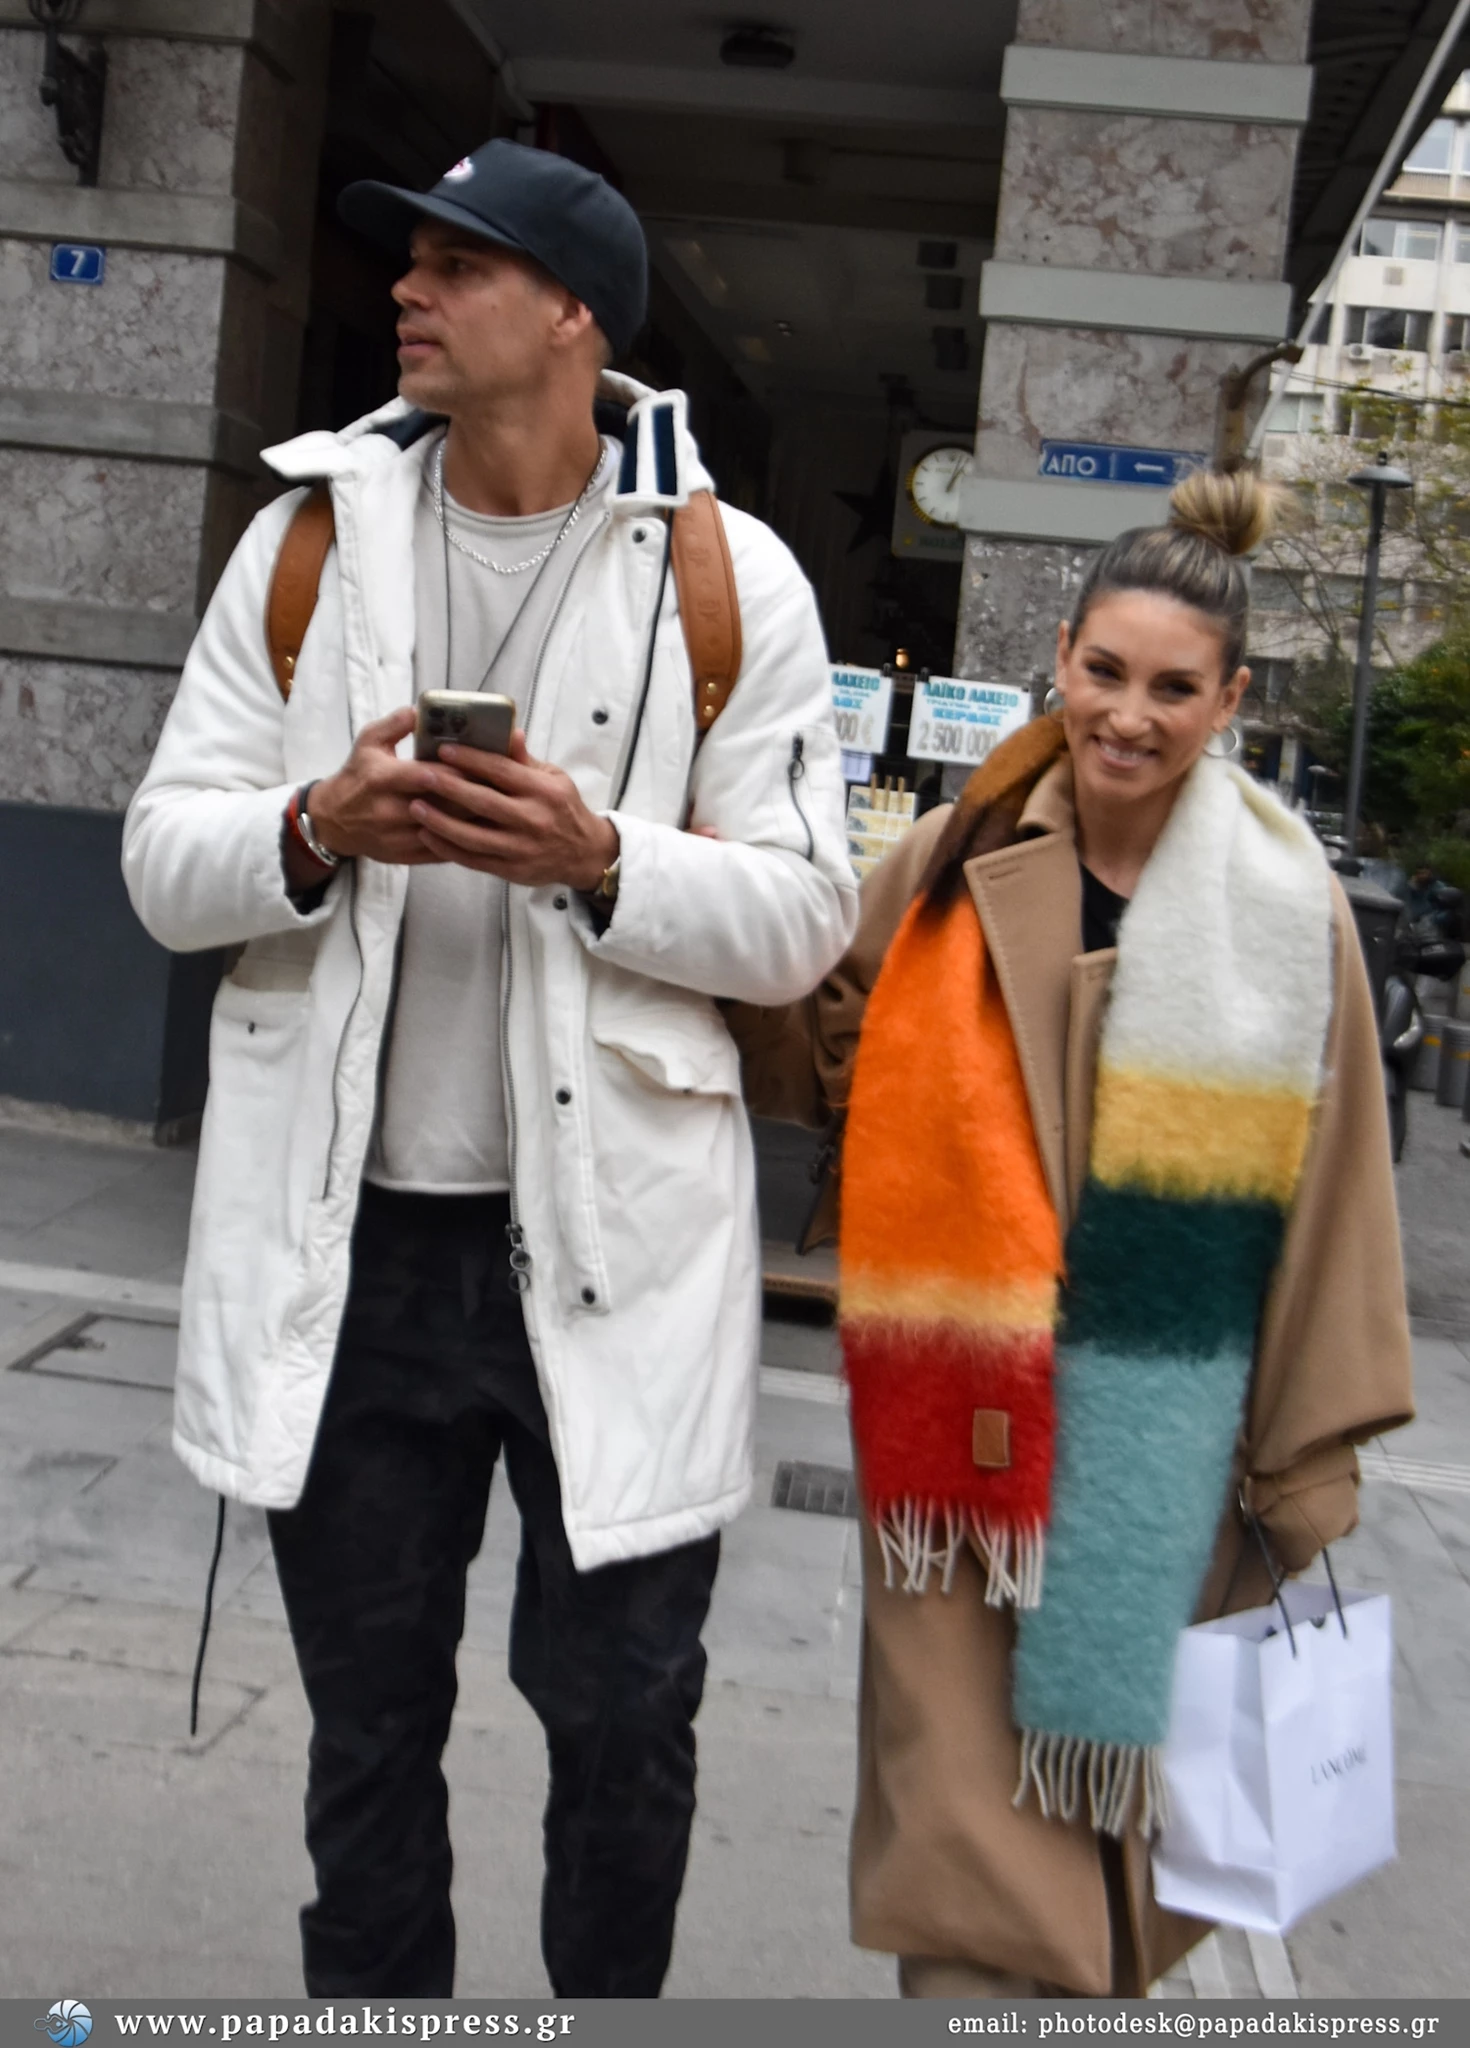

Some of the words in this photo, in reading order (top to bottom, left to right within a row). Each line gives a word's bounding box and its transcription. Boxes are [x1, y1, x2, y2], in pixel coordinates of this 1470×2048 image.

[70, 250, 86, 276] 7
[1046, 454, 1097, 476] ΑΠΟ
[916, 721, 929, 751] 2
[931, 722, 963, 755] 500
